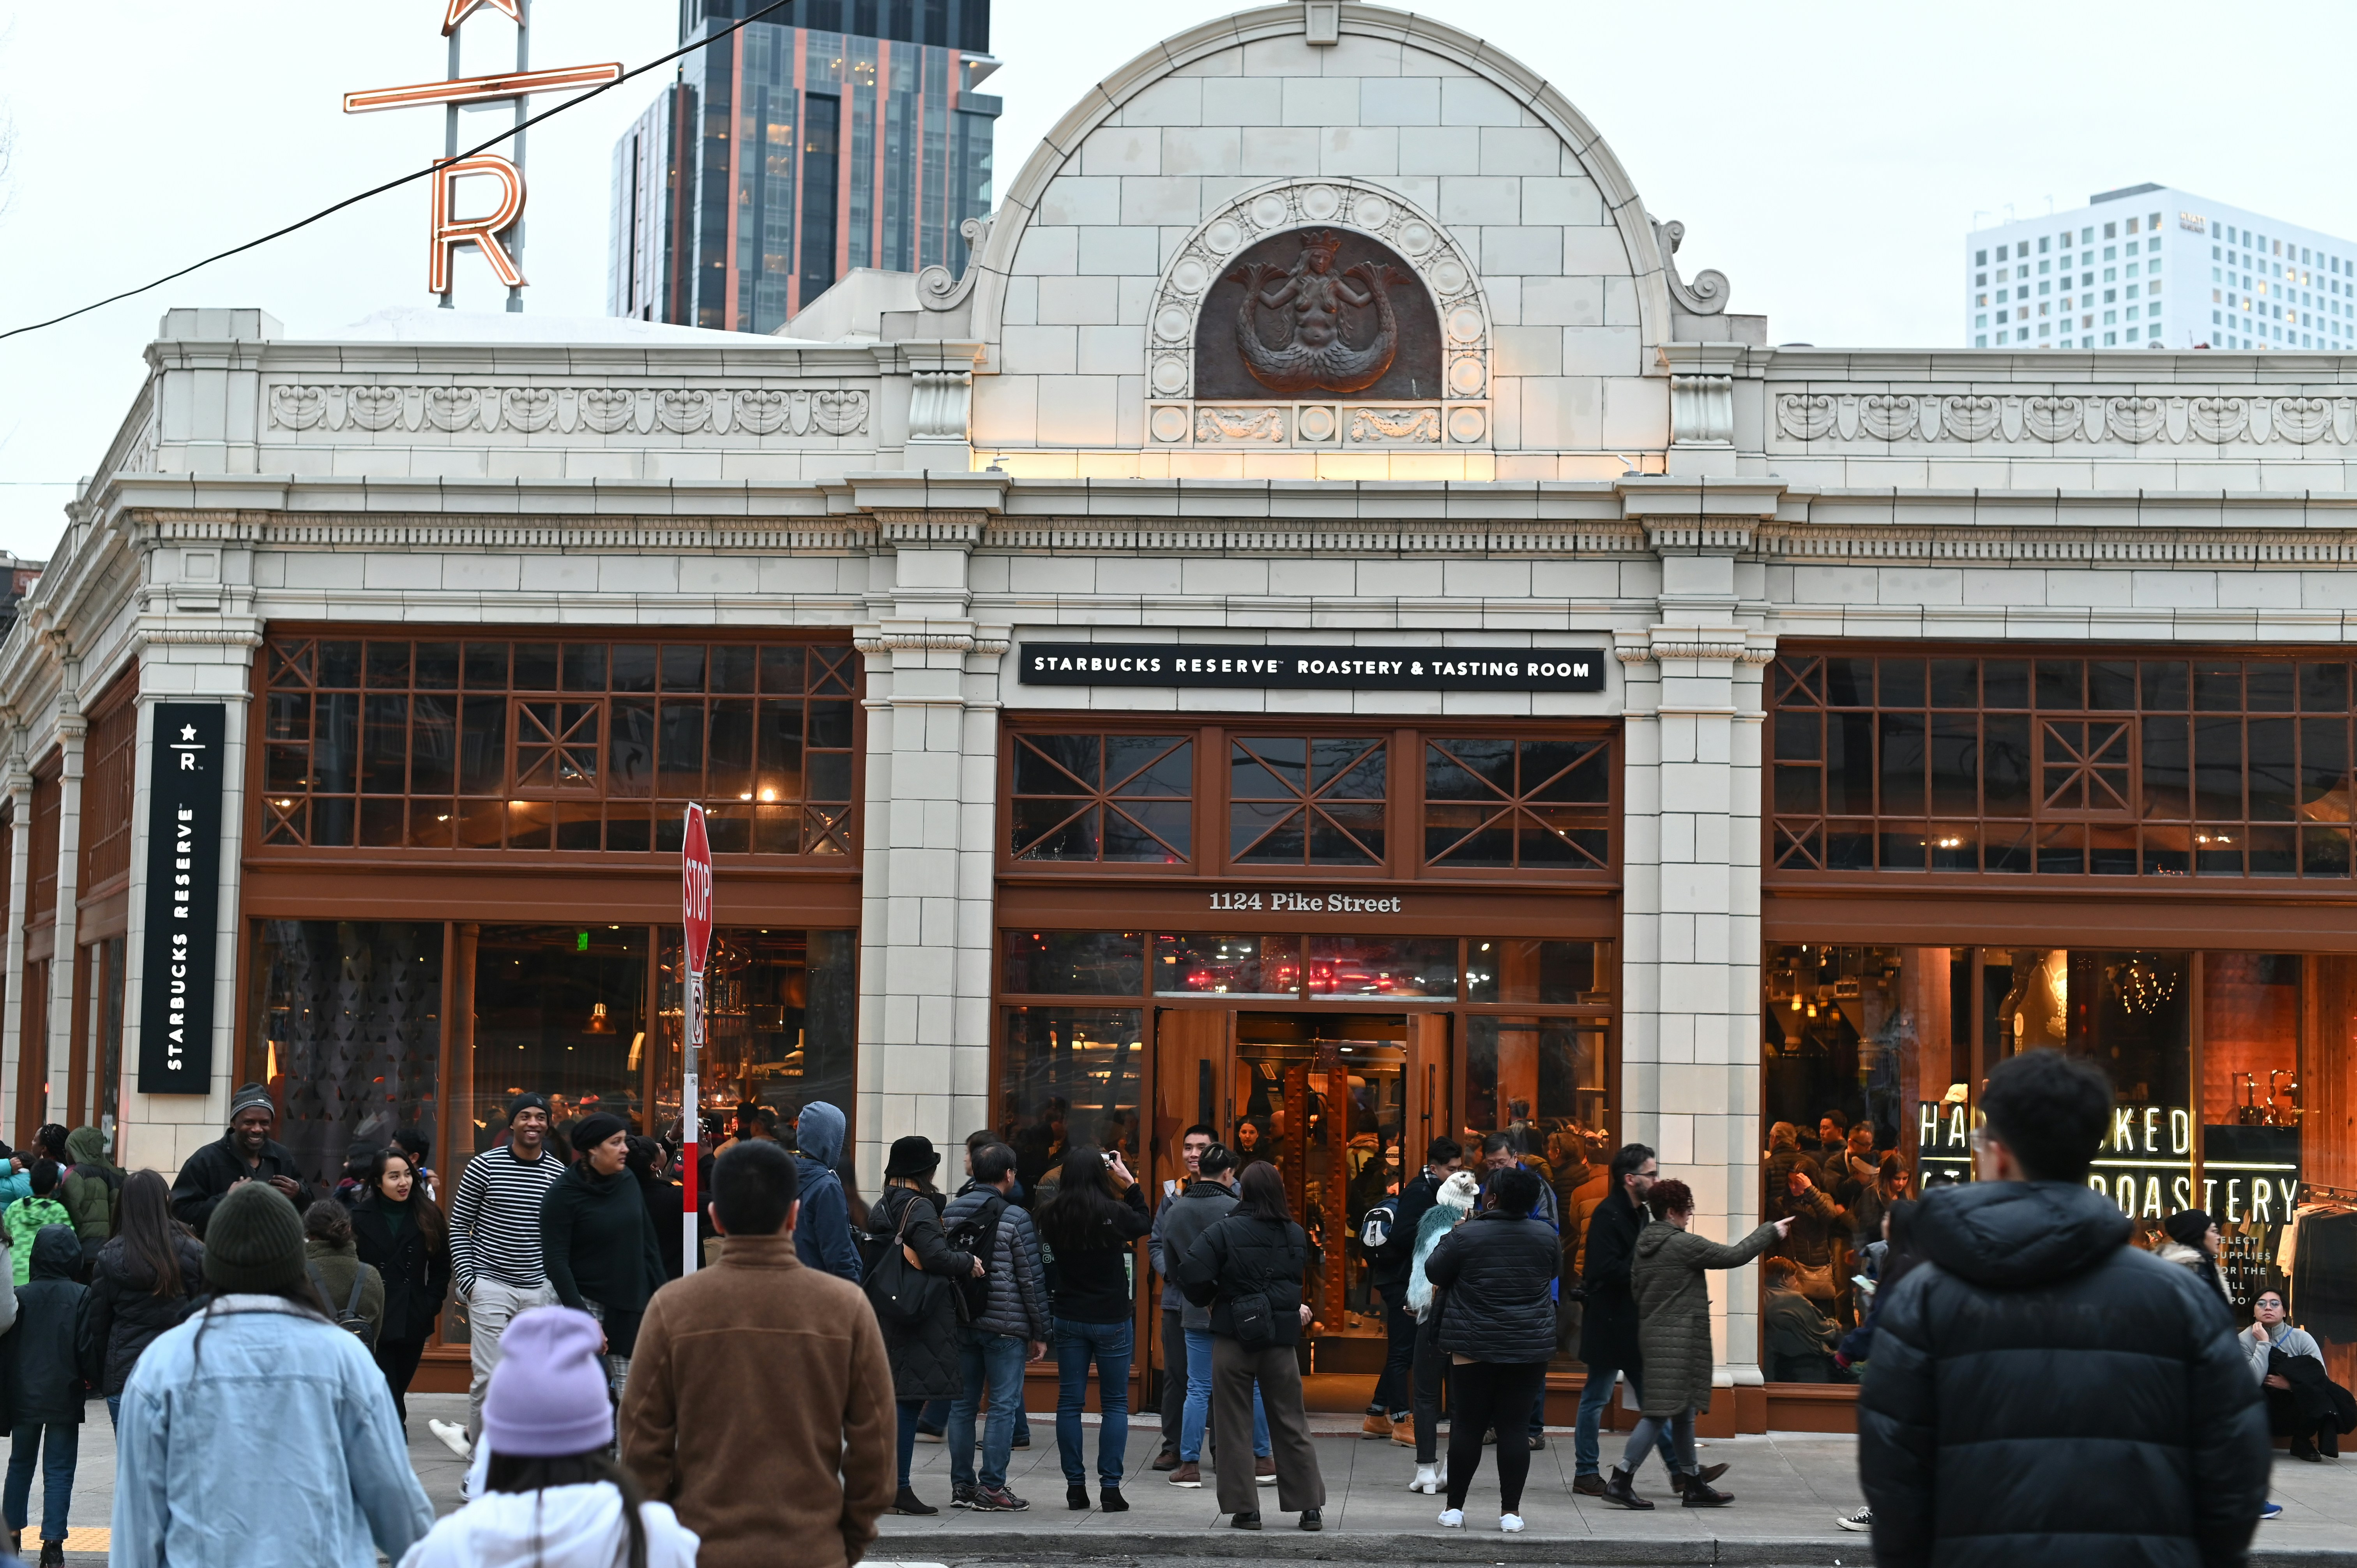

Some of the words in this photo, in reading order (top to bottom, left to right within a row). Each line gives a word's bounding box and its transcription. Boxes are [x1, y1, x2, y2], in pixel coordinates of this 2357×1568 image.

[429, 154, 529, 295] R
[2180, 212, 2206, 225] HYATT
[1035, 657, 1161, 672] STARBUCKS
[1298, 660, 1403, 675] ROASTERY
[1411, 661, 1424, 675] &
[1432, 662, 1518, 676] TASTING
[1527, 663, 1588, 677] ROOM
[181, 753, 195, 770] R
[686, 857, 709, 921] STOP
[1210, 893, 1262, 910] 1124
[1271, 893, 1323, 911] Pike
[1328, 894, 1401, 912] Street
[168, 934, 187, 1070] STARBUCKS
[2099, 1108, 2189, 1153] KED
[2220, 1236, 2258, 1244] ELECT
[2221, 1266, 2237, 1275] OR
[2243, 1267, 2266, 1275] THE
